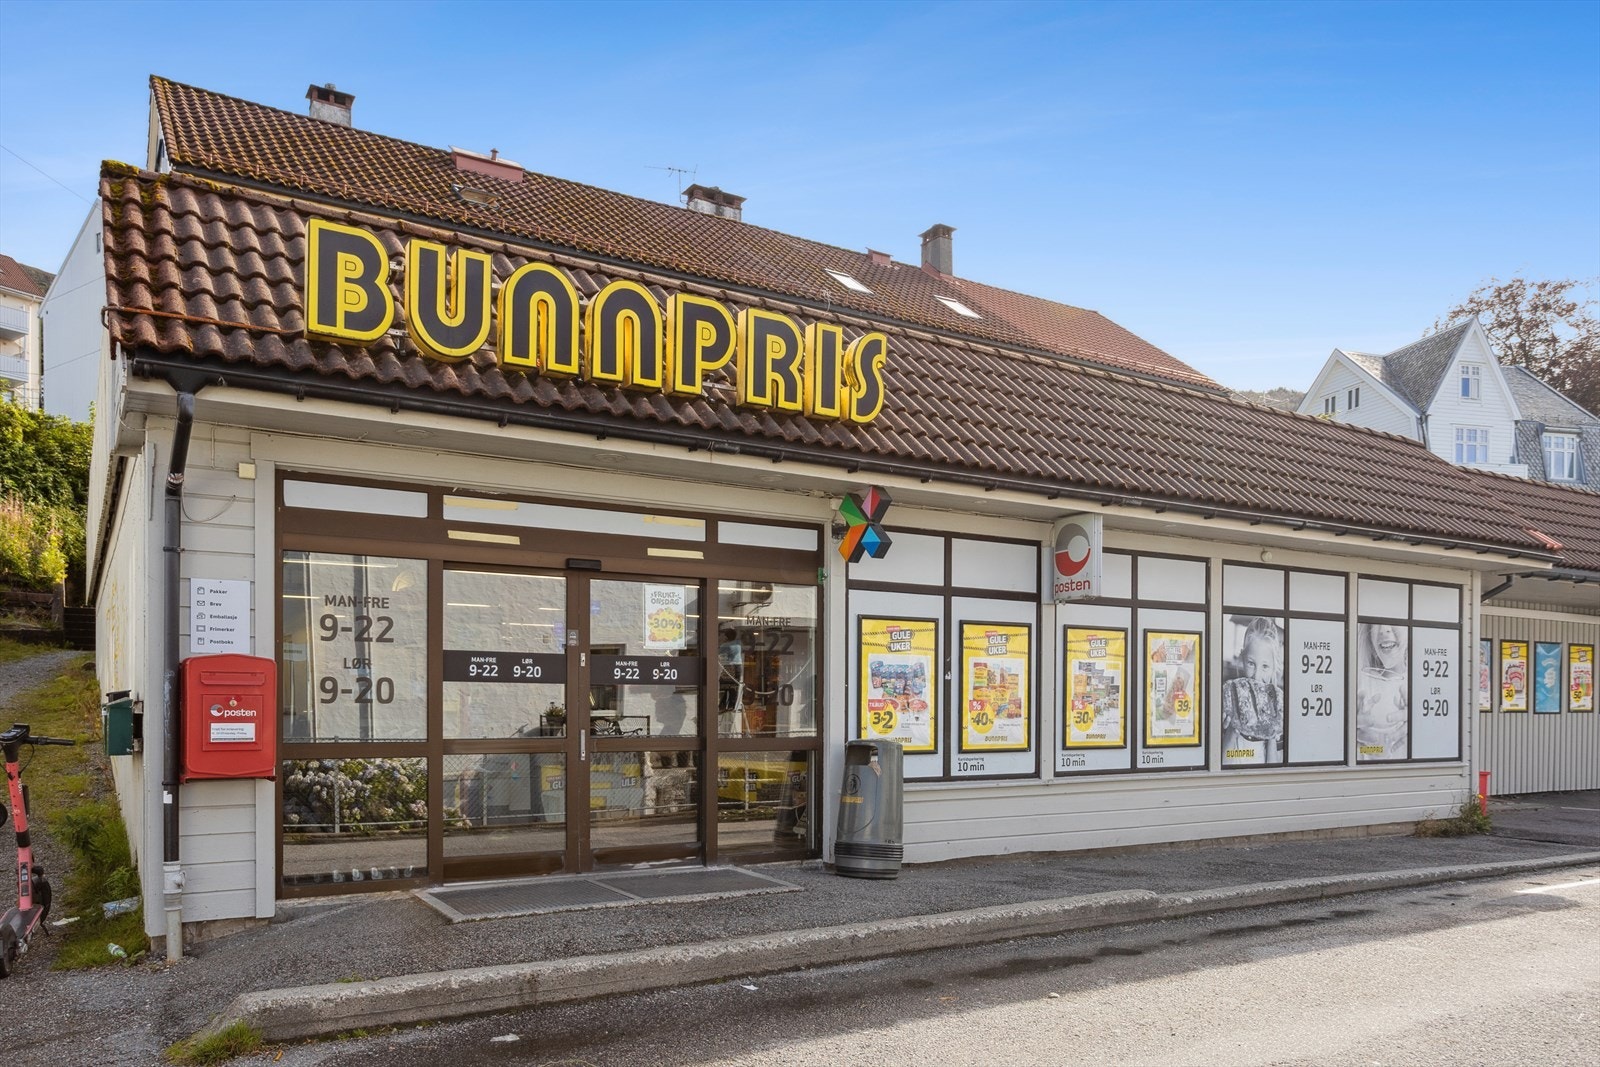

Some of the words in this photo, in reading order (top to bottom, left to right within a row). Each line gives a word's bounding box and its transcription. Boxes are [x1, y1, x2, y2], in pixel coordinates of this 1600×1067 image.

[304, 218, 887, 425] BUNNPRIS
[1055, 579, 1091, 596] posten
[324, 594, 390, 609] MAN-FRE
[746, 615, 792, 627] MAN-FRE
[319, 613, 395, 643] 9-22
[891, 631, 911, 640] GULE
[989, 635, 1007, 644] GULE
[890, 642, 911, 651] UKER
[1090, 639, 1106, 647] GULE
[1303, 641, 1331, 651] MAN-FRE
[988, 646, 1007, 655] UKER
[1090, 649, 1106, 657] UKER
[1424, 648, 1448, 656] MAN-FRE
[343, 657, 372, 670] LØR
[471, 656, 497, 664] MAN-FRE
[521, 657, 534, 665] LØR
[1301, 654, 1333, 674] 9-22
[469, 664, 499, 677] 9-22
[513, 665, 542, 678] 9-20
[613, 667, 640, 680] 9-22
[652, 668, 678, 680] 9-20
[1422, 660, 1449, 678] 9-22
[319, 675, 395, 705] 9-20
[1310, 684, 1323, 693] LØR
[1430, 687, 1441, 695] LØR
[1301, 697, 1333, 717] 9-20
[1422, 699, 1449, 717] 9-20
[224, 708, 257, 718] posten
[1226, 749, 1255, 758] BUNNPRIS
[1061, 758, 1071, 767] 10
[1071, 757, 1086, 767] min
[1141, 755, 1151, 764] 10
[1151, 755, 1164, 764] min
[957, 762, 968, 772] 10
[969, 761, 985, 771] min
